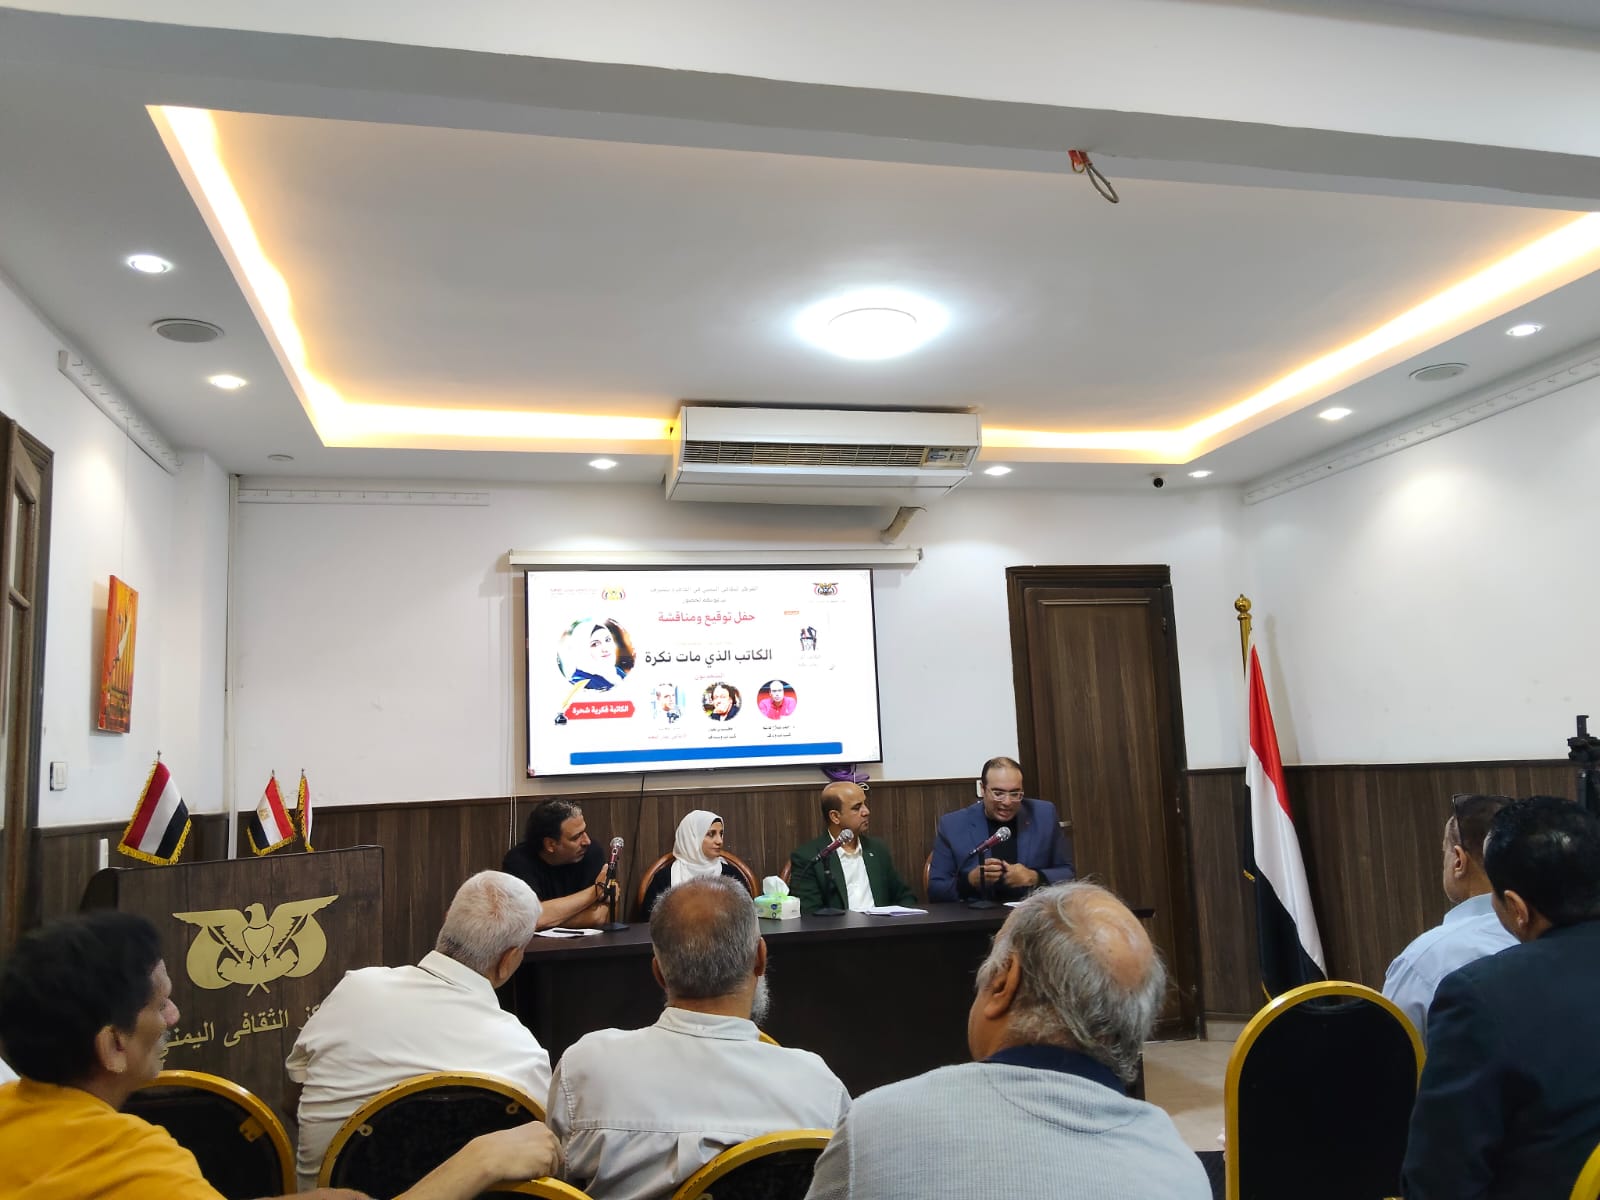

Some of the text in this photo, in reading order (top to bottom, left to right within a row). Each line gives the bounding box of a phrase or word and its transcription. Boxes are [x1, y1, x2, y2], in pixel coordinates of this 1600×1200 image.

[658, 610, 755, 627] حفل توقيع ومناقشة
[645, 648, 772, 669] الكاتب الذي مات نكرة
[573, 704, 629, 716] الكاتبة فكرية شحرة
